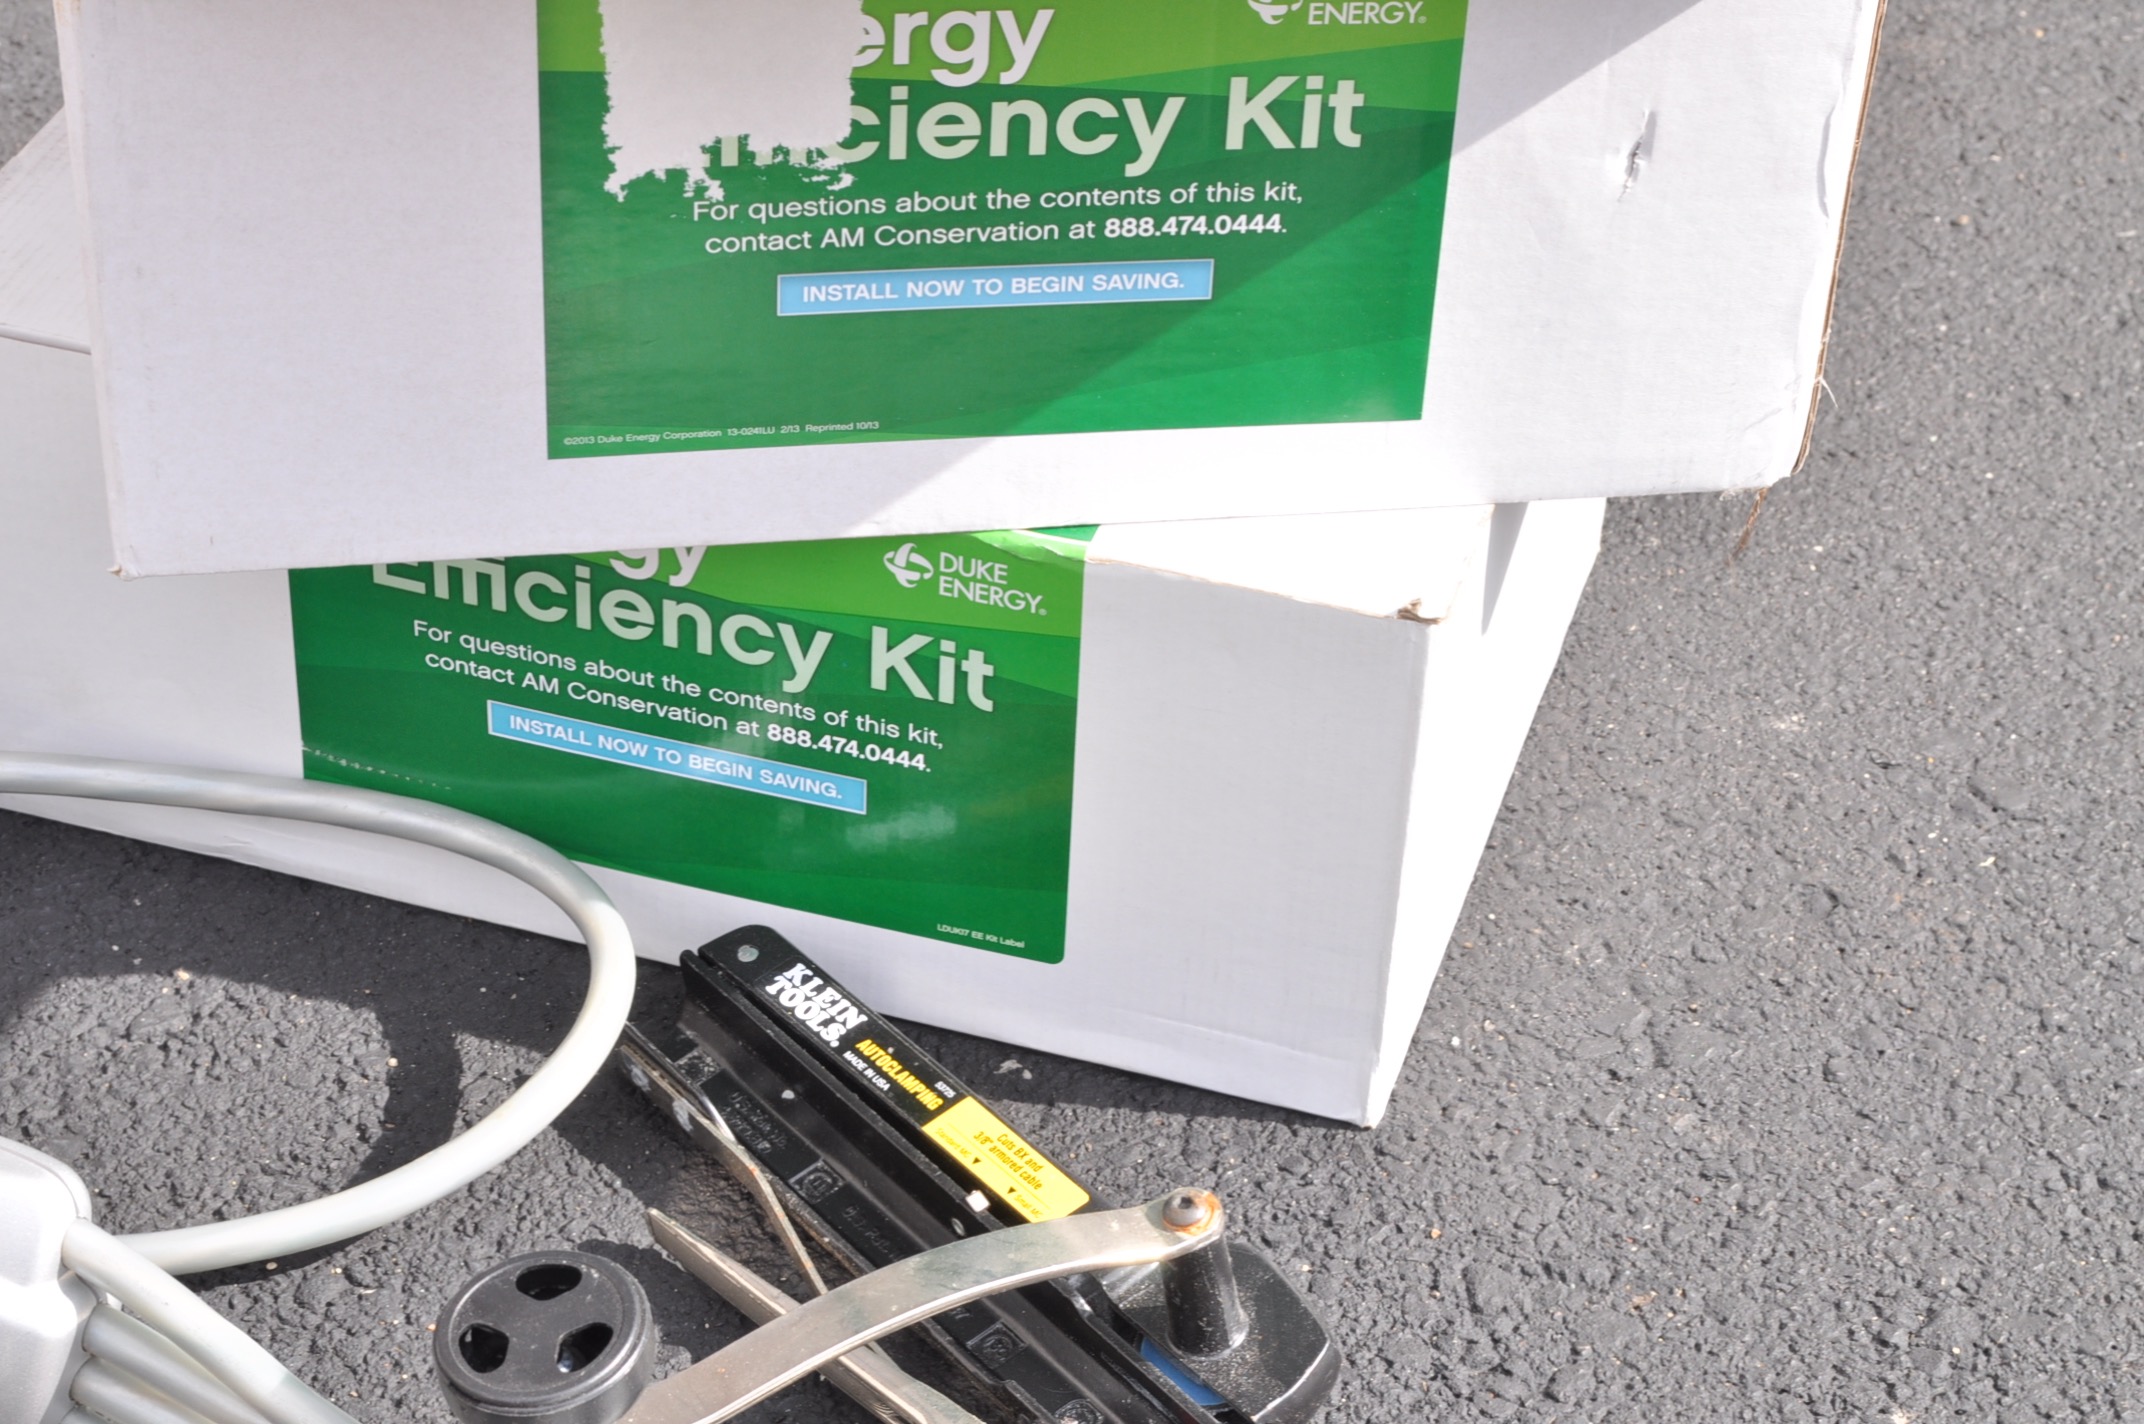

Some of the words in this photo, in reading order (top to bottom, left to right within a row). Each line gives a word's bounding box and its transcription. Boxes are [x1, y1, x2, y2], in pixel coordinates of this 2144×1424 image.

[852, 9, 1056, 86] ergy
[1225, 76, 1365, 150] Kit
[693, 200, 739, 222] For
[748, 196, 886, 224] questions
[895, 191, 977, 213] about
[986, 188, 1031, 210] the
[1039, 186, 1161, 208] contents
[1170, 182, 1198, 204] of
[1206, 181, 1255, 203] this
[1264, 181, 1302, 204] kit,
[705, 231, 812, 254] contact
[820, 227, 864, 248] AM
[874, 221, 1059, 247] Conservation
[1069, 220, 1096, 240] at
[1104, 213, 1287, 239] 888.474.0444.
[802, 283, 899, 302] INSTALL
[906, 279, 965, 298] NOW
[972, 278, 1003, 296] TO
[1011, 275, 1084, 294] BEGIN
[1092, 272, 1184, 291] SAVING.
[597, 434, 623, 443] Duke
[625, 433, 660, 443] Energy
[663, 429, 722, 440] Corporation
[805, 421, 853, 433] Reprinted
[939, 551, 1008, 585] DUKE
[413, 619, 452, 643] For
[459, 633, 577, 671] questions
[584, 659, 655, 688] about
[661, 672, 701, 697] the
[708, 687, 816, 722] contents
[823, 710, 848, 727] of
[855, 714, 900, 738] this
[908, 723, 943, 749] kit,
[870, 624, 994, 712] Kit
[425, 653, 515, 685] contact
[521, 671, 559, 695] AM
[567, 682, 728, 730] Conservation
[736, 719, 760, 738] at
[767, 723, 931, 773] 888.474.0444.
[509, 714, 592, 746] INSTALL
[598, 734, 648, 758] NOW
[654, 746, 682, 764] TO
[688, 753, 752, 780] BEGIN
[759, 768, 842, 799] SAVING.
[999, 936, 1025, 948] Label
[782, 963, 868, 1029] KLEIN
[842, 1050, 868, 1071] MADE
[863, 1067, 877, 1079] IN
[872, 1075, 891, 1091] USA
[855, 1039, 944, 1111] AUTOCLAMPING
[988, 1145, 1023, 1173] armored
[1019, 1170, 1043, 1190] cable
[996, 1133, 1016, 1152] Cuts
[1013, 1147, 1030, 1160] BX
[1024, 1158, 1044, 1173] and
